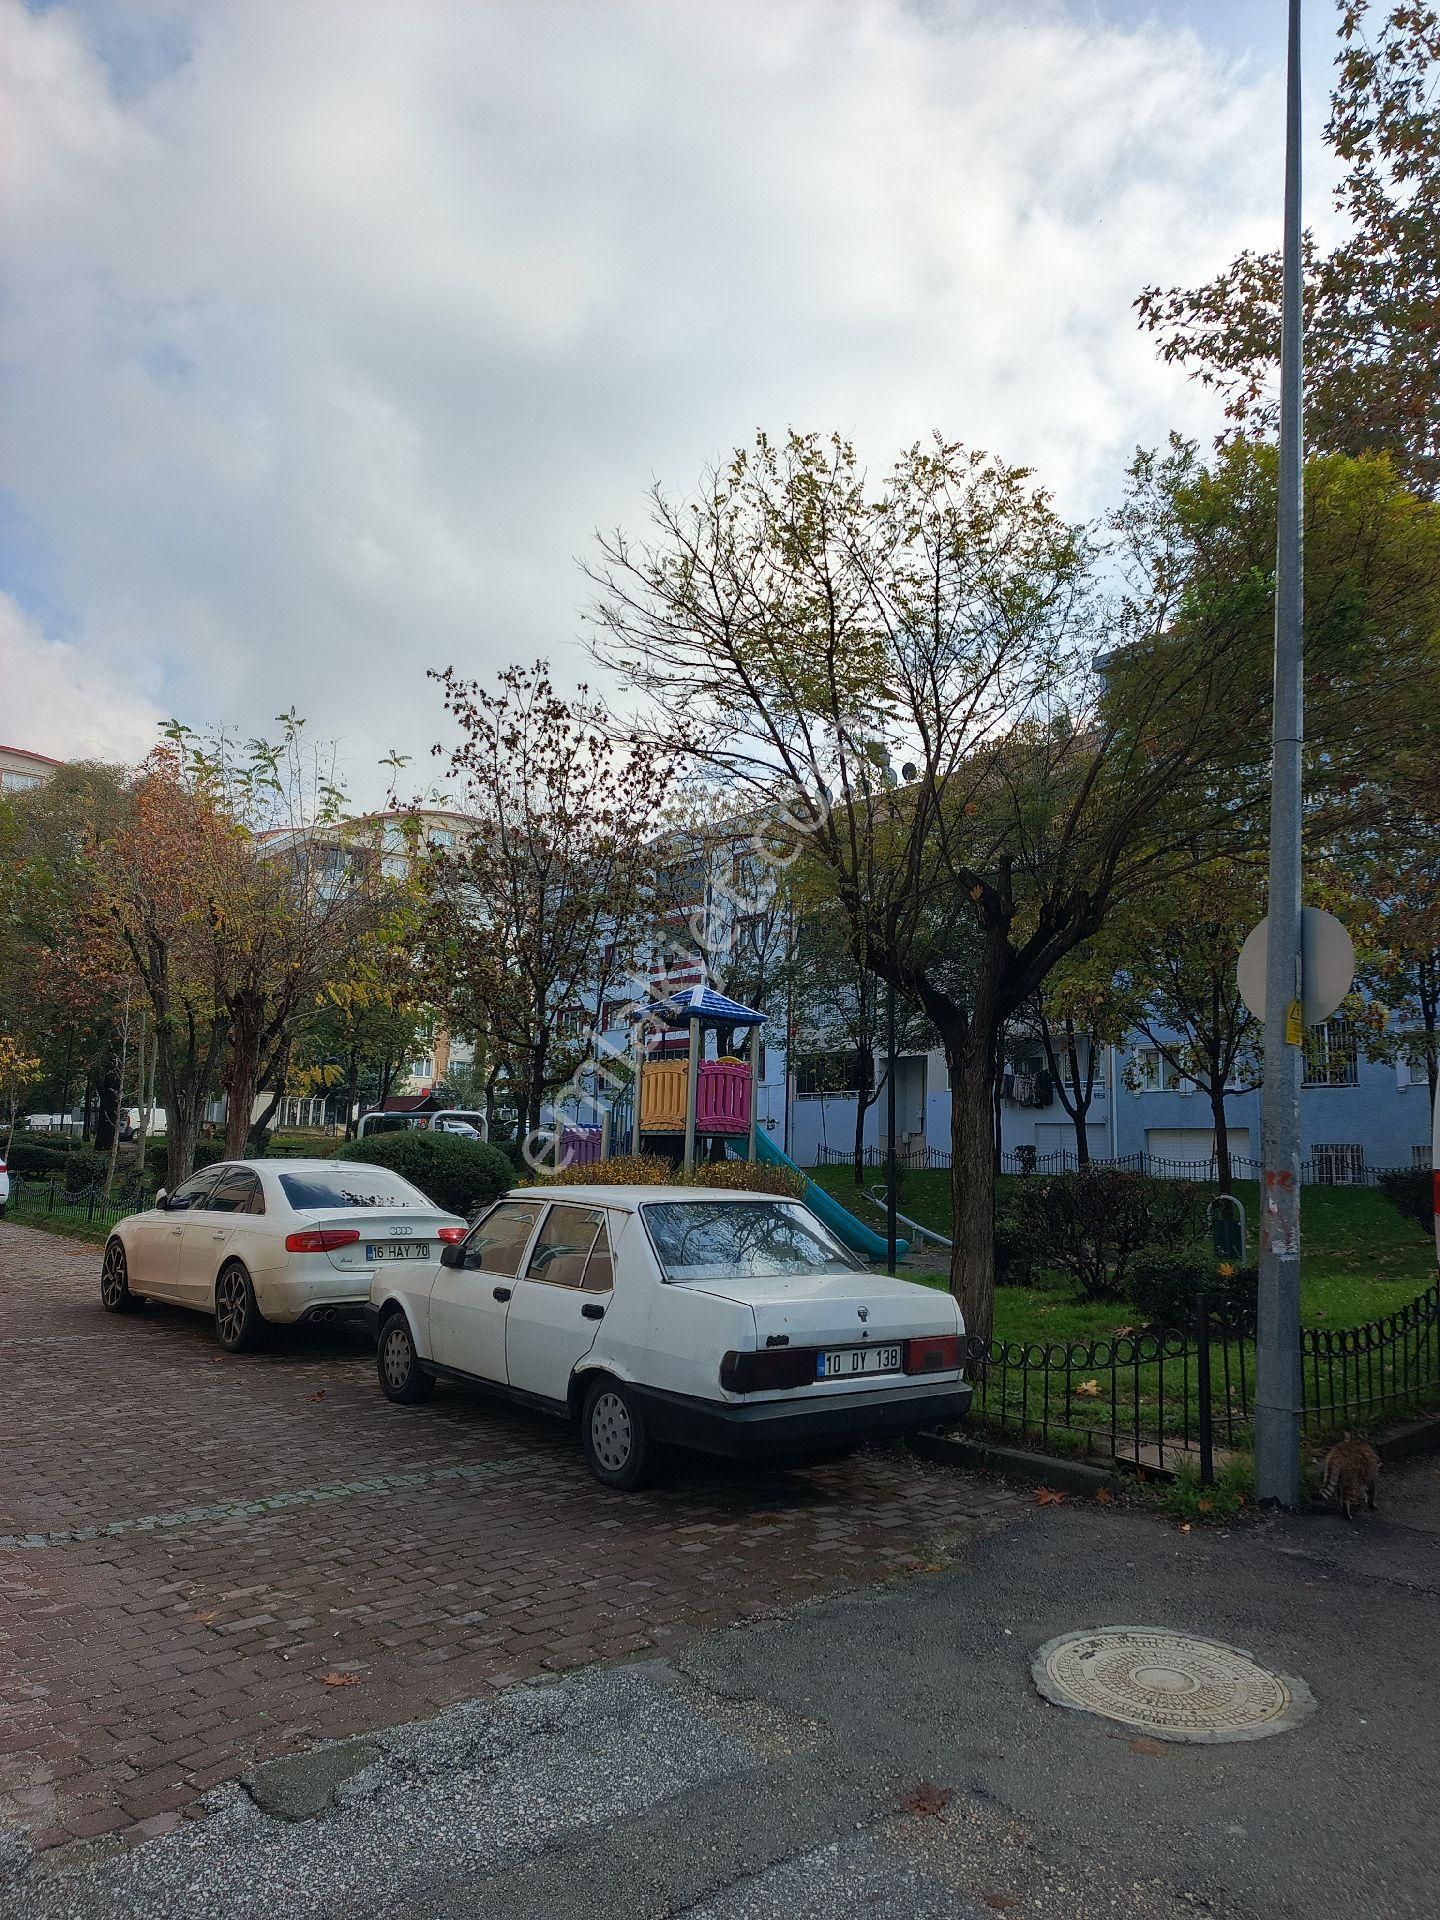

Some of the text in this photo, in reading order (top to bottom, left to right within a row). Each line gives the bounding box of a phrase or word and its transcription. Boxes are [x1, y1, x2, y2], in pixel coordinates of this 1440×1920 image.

[373, 1245, 429, 1259] 16 HAY 70
[826, 1348, 898, 1374] 10 DY 138
